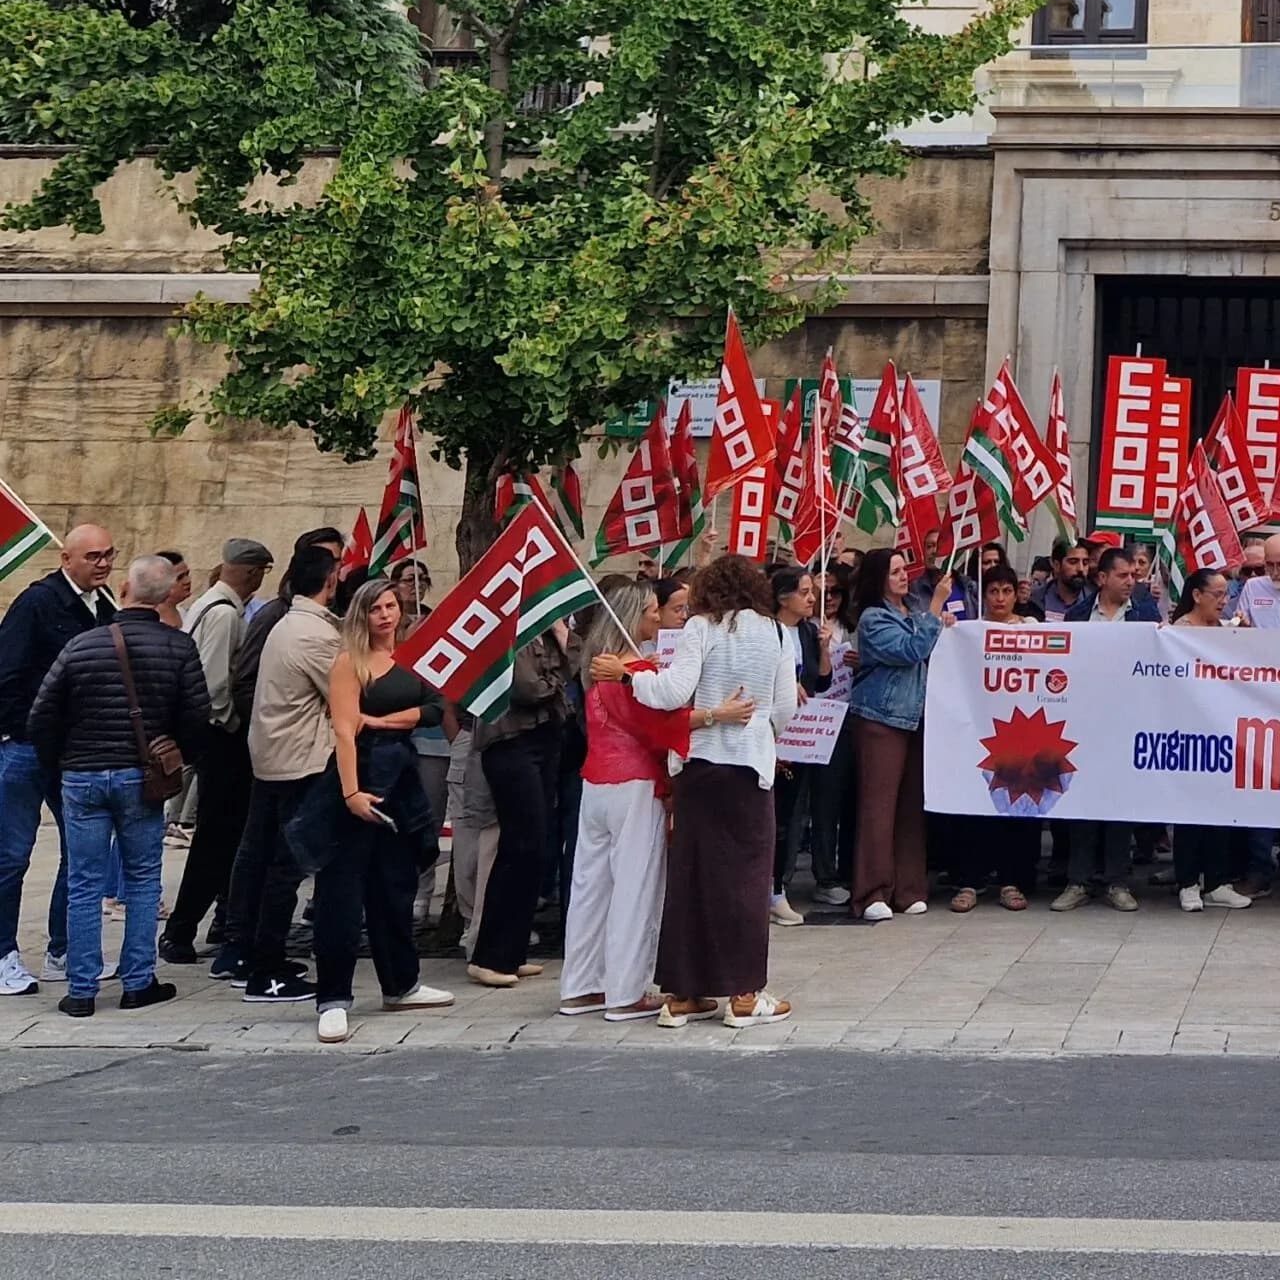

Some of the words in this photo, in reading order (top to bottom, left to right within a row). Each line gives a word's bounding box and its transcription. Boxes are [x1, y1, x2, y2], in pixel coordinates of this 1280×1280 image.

[1109, 362, 1153, 509] CCOO
[989, 634, 1043, 649] CCOO
[984, 667, 1040, 693] UGT
[1132, 660, 1170, 678] Ante
[1175, 662, 1189, 678] el
[1133, 729, 1233, 773] exigimos
